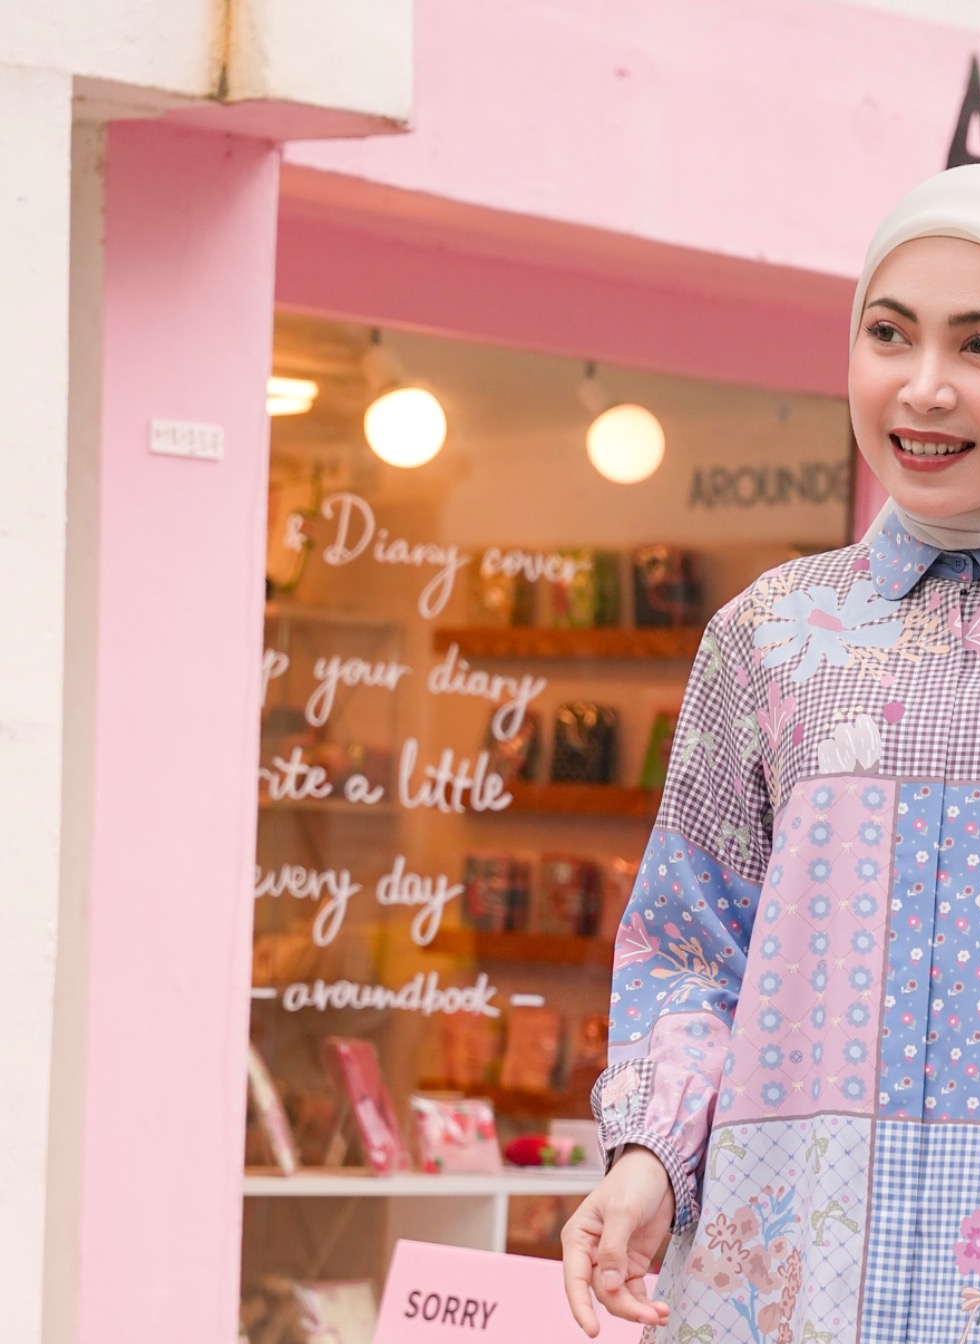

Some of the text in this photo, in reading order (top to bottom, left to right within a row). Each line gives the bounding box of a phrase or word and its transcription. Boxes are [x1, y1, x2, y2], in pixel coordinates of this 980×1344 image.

[321, 492, 472, 619] Diary
[305, 654, 412, 728] your
[427, 643, 547, 741] diary
[344, 773, 384, 805] a
[399, 737, 513, 814] little
[376, 854, 464, 947] day
[404, 1290, 497, 1329] SORRY
